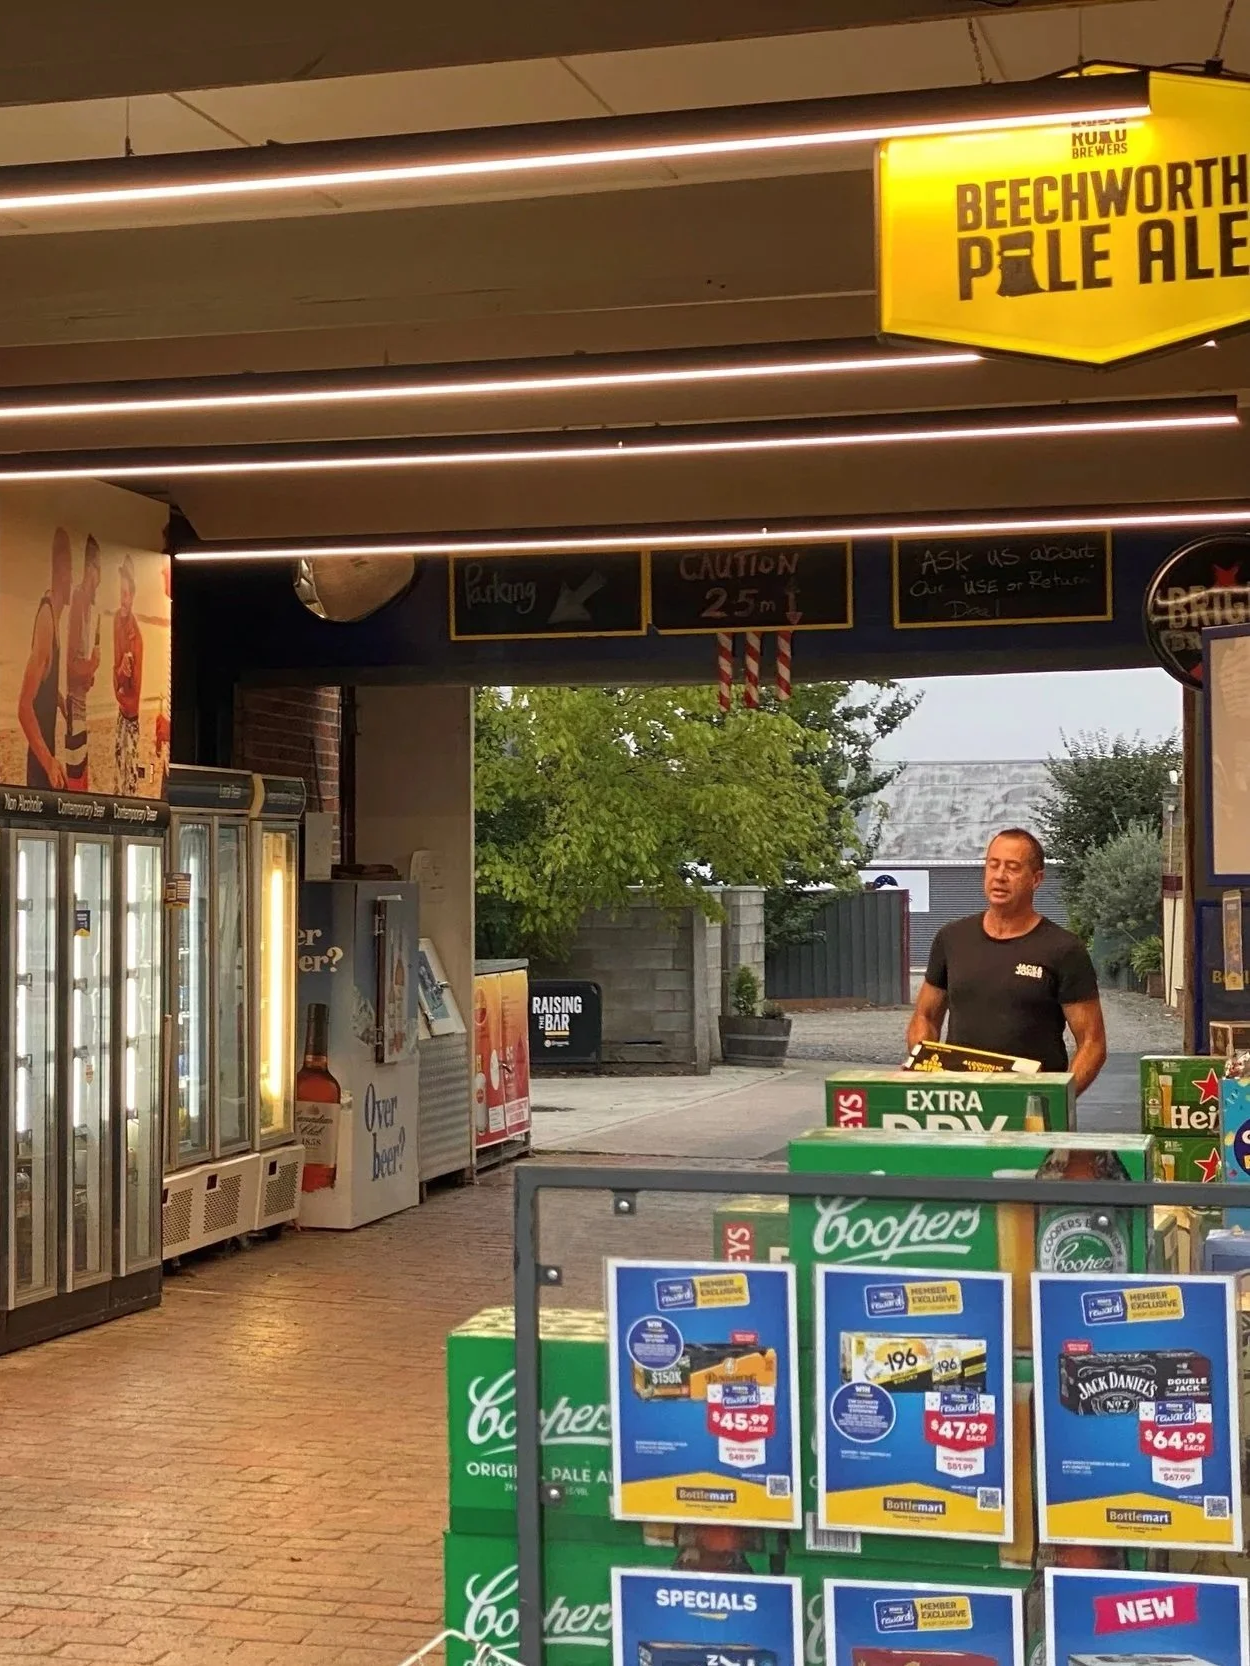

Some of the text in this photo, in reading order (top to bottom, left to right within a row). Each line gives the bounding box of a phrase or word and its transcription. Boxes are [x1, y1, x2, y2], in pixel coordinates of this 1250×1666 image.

[1071, 143, 1128, 160] BREWERS
[956, 153, 1249, 233] BEECHWORTH
[1137, 210, 1250, 285] ALE
[679, 550, 799, 581] CAUTION
[463, 563, 537, 615] Parking
[18, 795, 43, 813] Alcoholic
[57, 798, 106, 819] Contemporary Beer
[113, 803, 158, 824] Contemporary Beer
[532, 995, 583, 1014] RAISING
[545, 1014, 570, 1031] BAR
[364, 1082, 397, 1133] Over
[905, 1089, 984, 1112] EXTRA
[371, 1126, 406, 1182] beer?
[911, 1286, 948, 1295] MEMBER
[911, 1294, 957, 1304] EXCLUSIVE
[1130, 1291, 1167, 1300] MEMBER
[1130, 1299, 1178, 1310] EXCLUSIVE
[855, 1385, 871, 1393] WIN
[1077, 1371, 1158, 1400] JACK DANIEL'S
[1167, 1377, 1207, 1386] DOUBLE
[712, 1411, 769, 1431] $45.99
[1155, 1407, 1197, 1422] rewards
[931, 1419, 988, 1440] $47.99
[1144, 1429, 1206, 1450] $64.99
[551, 1467, 591, 1483] PALE
[1163, 1473, 1191, 1483] $67.99
[679, 1489, 736, 1502] Bottlemart
[886, 1499, 943, 1513] Bottlemart
[1109, 1510, 1170, 1524] Bottlemart
[656, 1589, 758, 1611] SPECIALS
[920, 1601, 957, 1610] MEMBER
[921, 1609, 967, 1619] EXCLUSIVE
[1116, 1595, 1175, 1624] NEW
